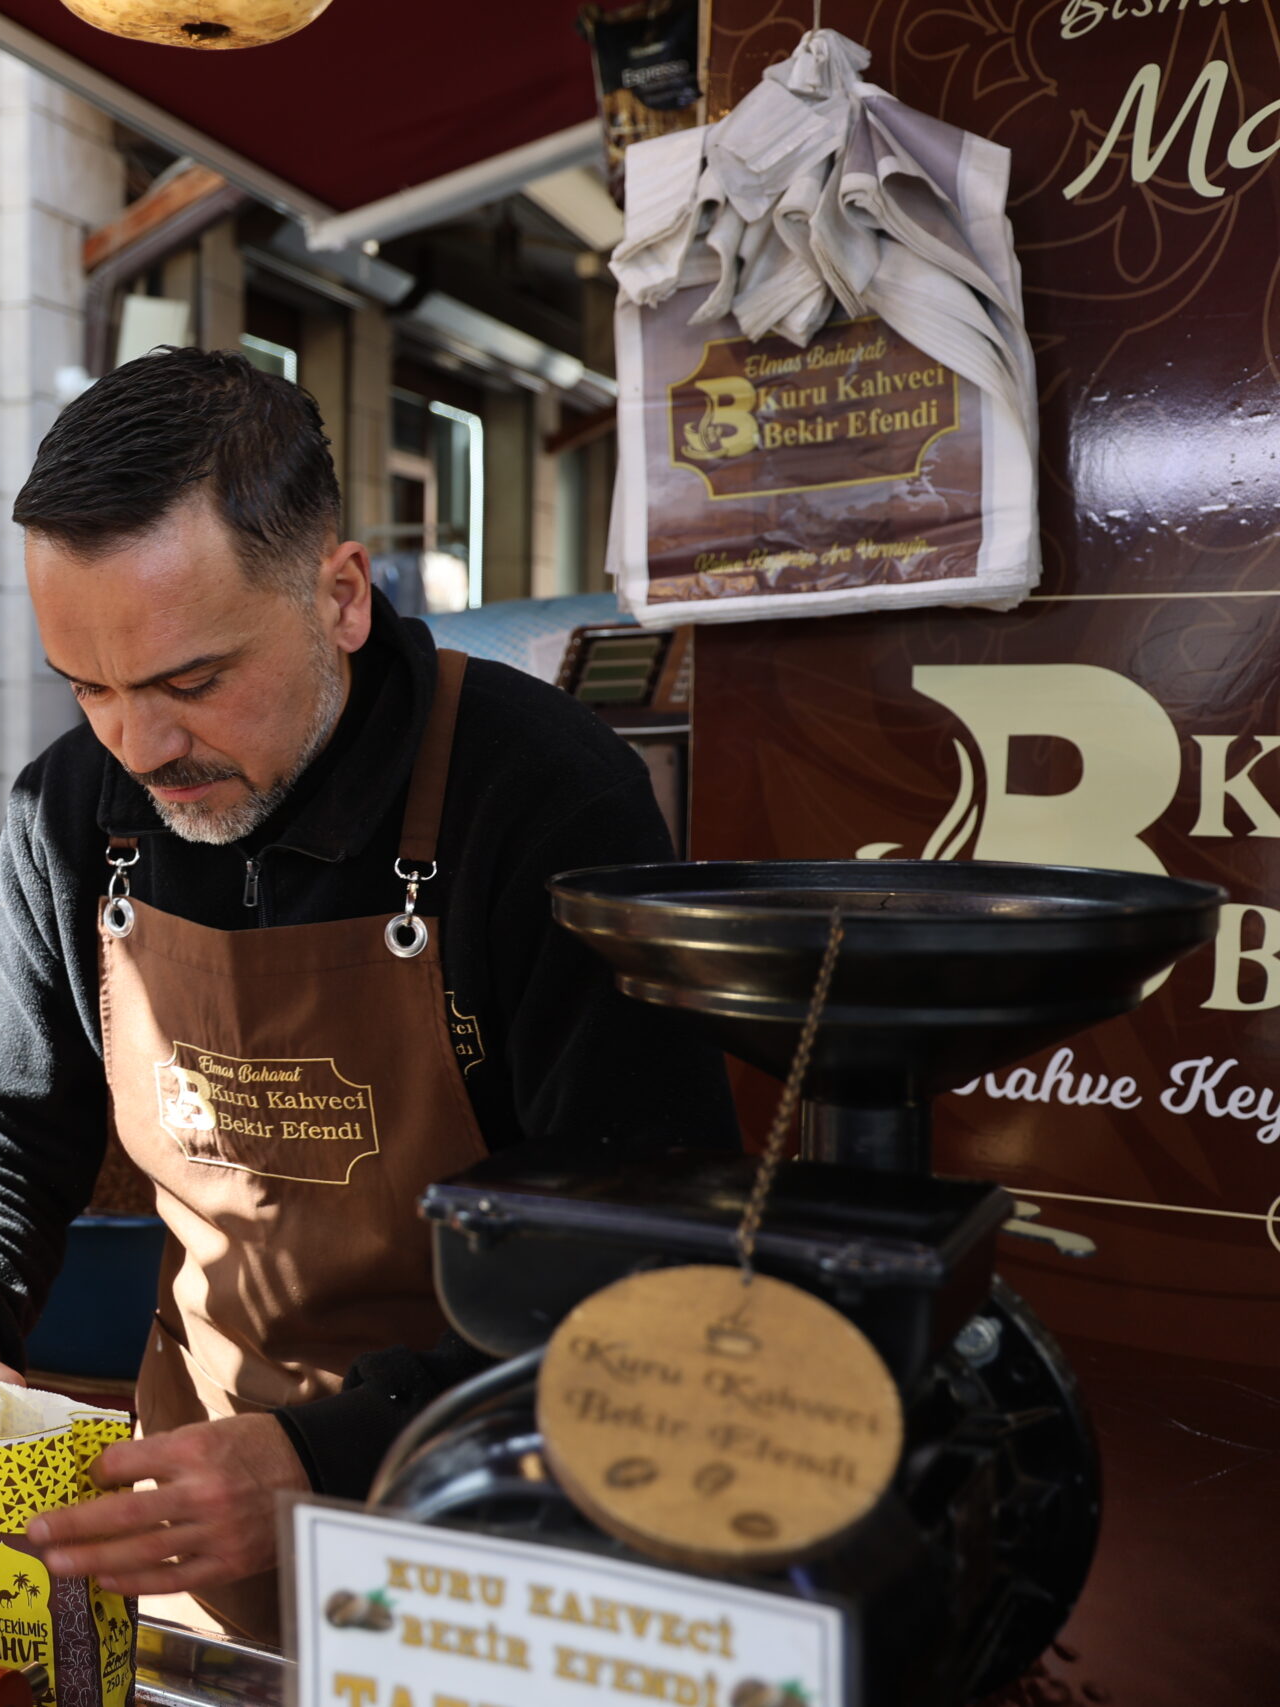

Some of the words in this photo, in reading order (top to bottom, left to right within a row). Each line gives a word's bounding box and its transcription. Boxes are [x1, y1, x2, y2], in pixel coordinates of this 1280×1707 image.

[744, 354, 802, 378] Elmas
[807, 336, 887, 370] Baharat
[757, 385, 827, 412] Kuru
[836, 362, 945, 401] Kahveci
[764, 416, 839, 449] Bekir
[846, 399, 938, 438] Efendi
[198, 1055, 234, 1078] Elmas
[238, 1064, 304, 1084] Baharat
[209, 1082, 260, 1109] Kuru
[266, 1091, 367, 1110] Kahveci
[218, 1112, 275, 1138] Bekir
[280, 1121, 364, 1140] Efendi
[386, 1557, 506, 1608] KURU
[400, 1614, 532, 1671] BEKİR
